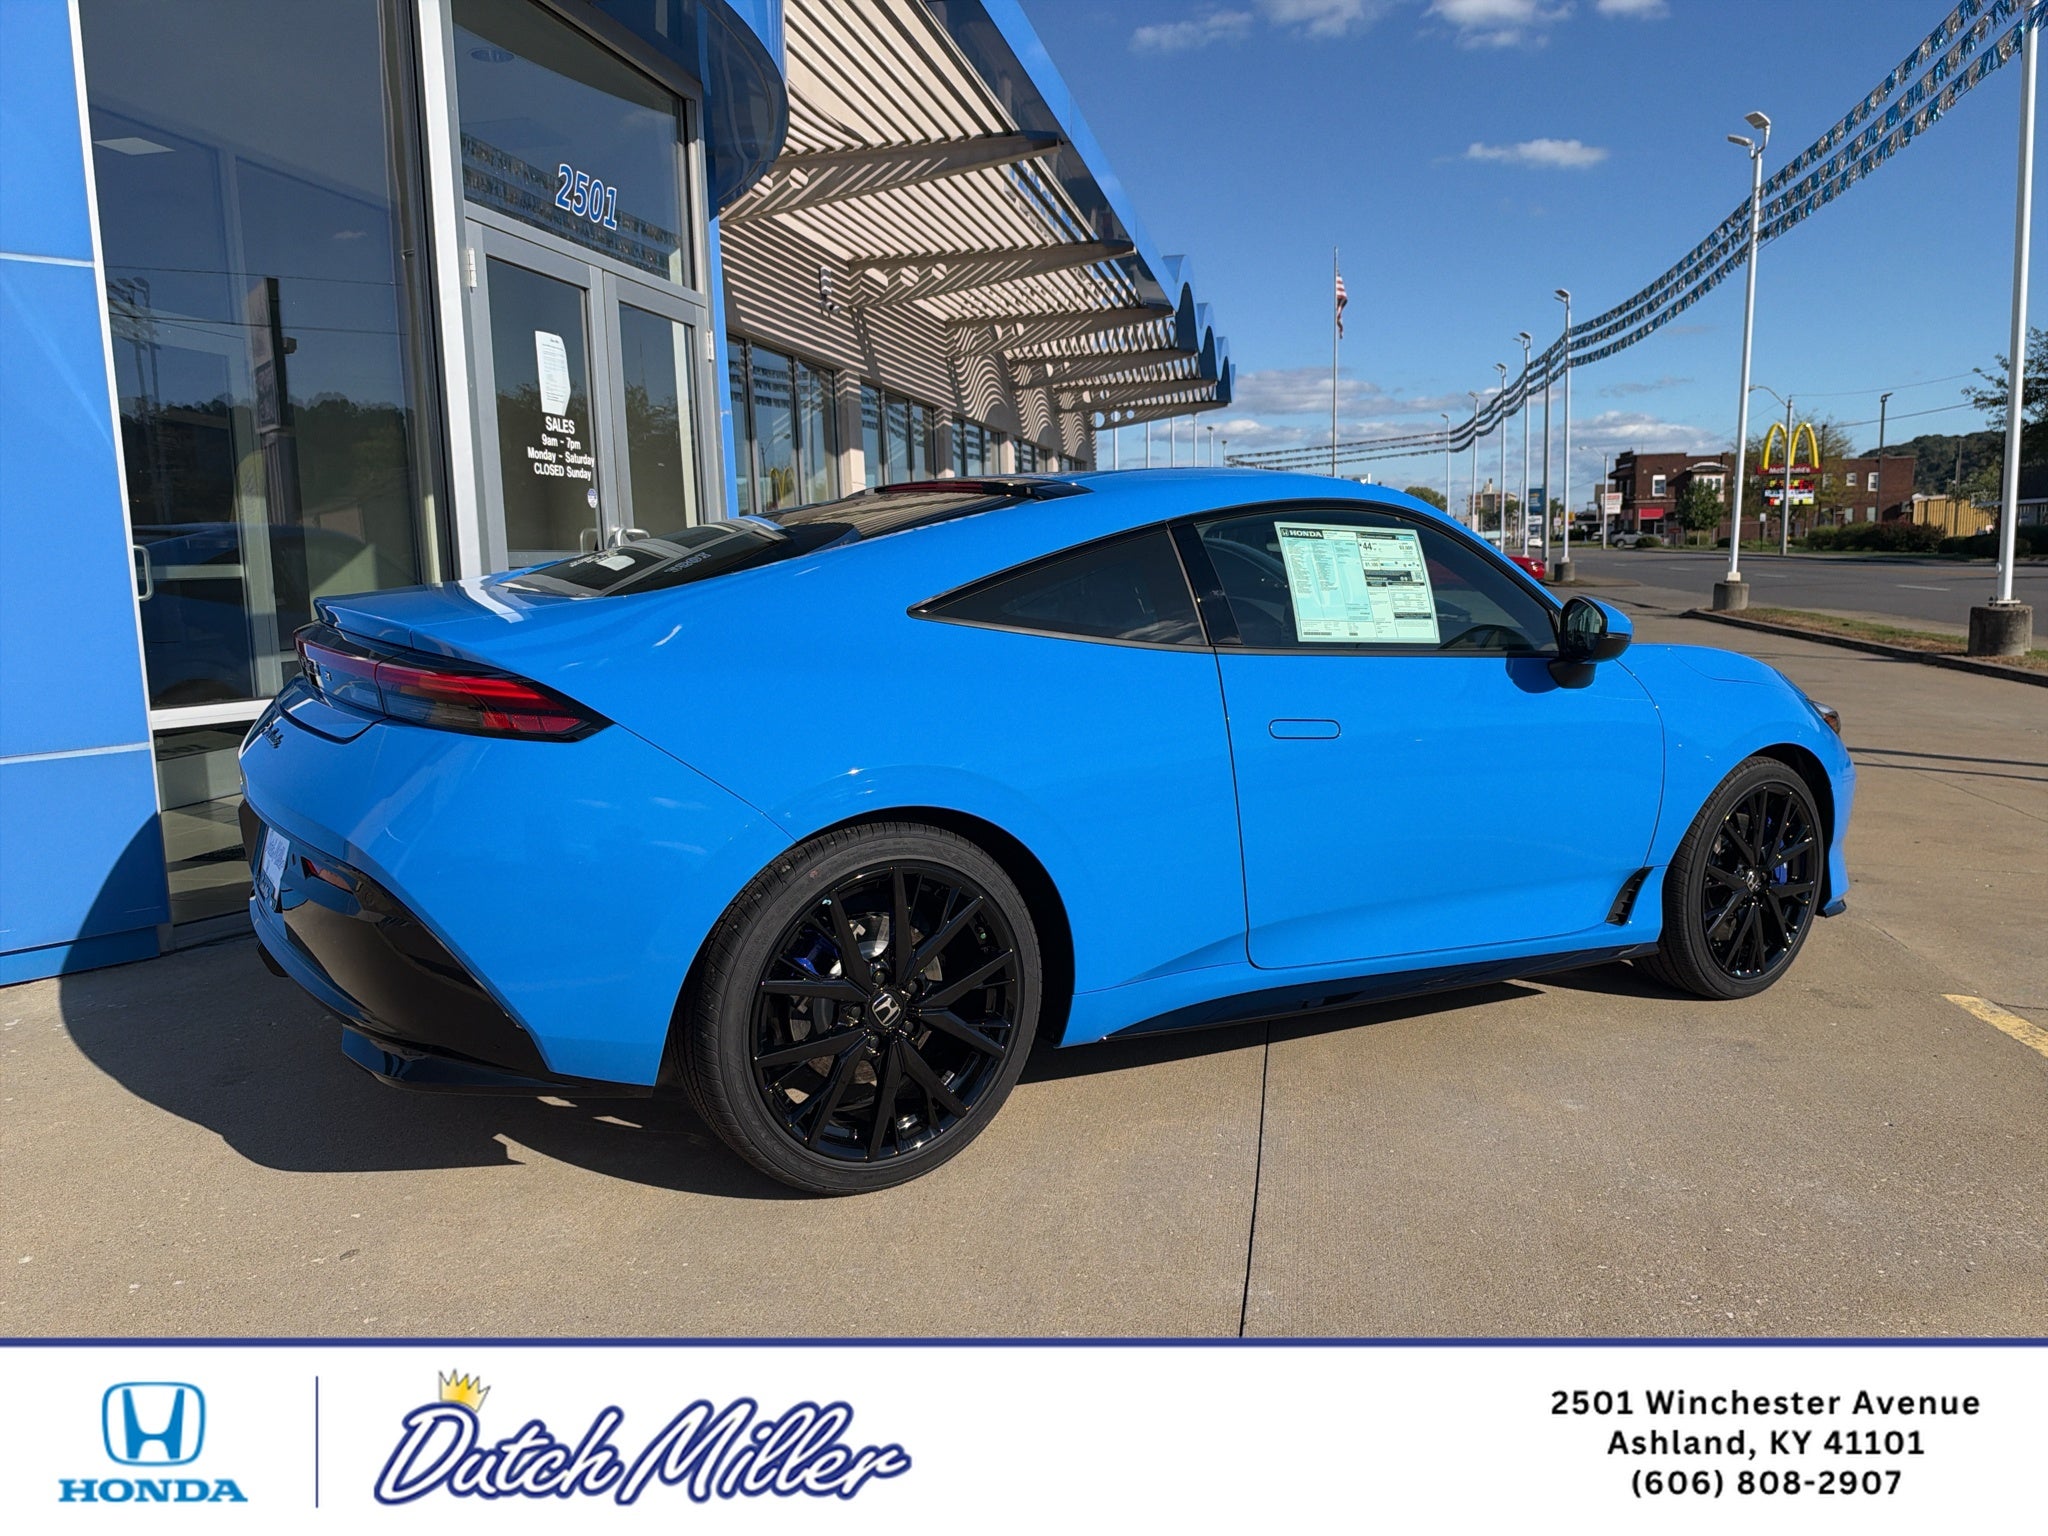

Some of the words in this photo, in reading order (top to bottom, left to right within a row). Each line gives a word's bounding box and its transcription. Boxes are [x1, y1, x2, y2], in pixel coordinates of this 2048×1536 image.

[555, 163, 617, 231] 2501
[545, 416, 575, 434] SALES
[541, 433, 558, 446] 9am
[566, 437, 581, 451] 7pm
[527, 447, 556, 463] Monday
[565, 452, 595, 467] Saturday
[534, 463, 564, 477] CLOSED
[567, 465, 591, 481] Sunday
[1289, 530, 1323, 538] HONDA
